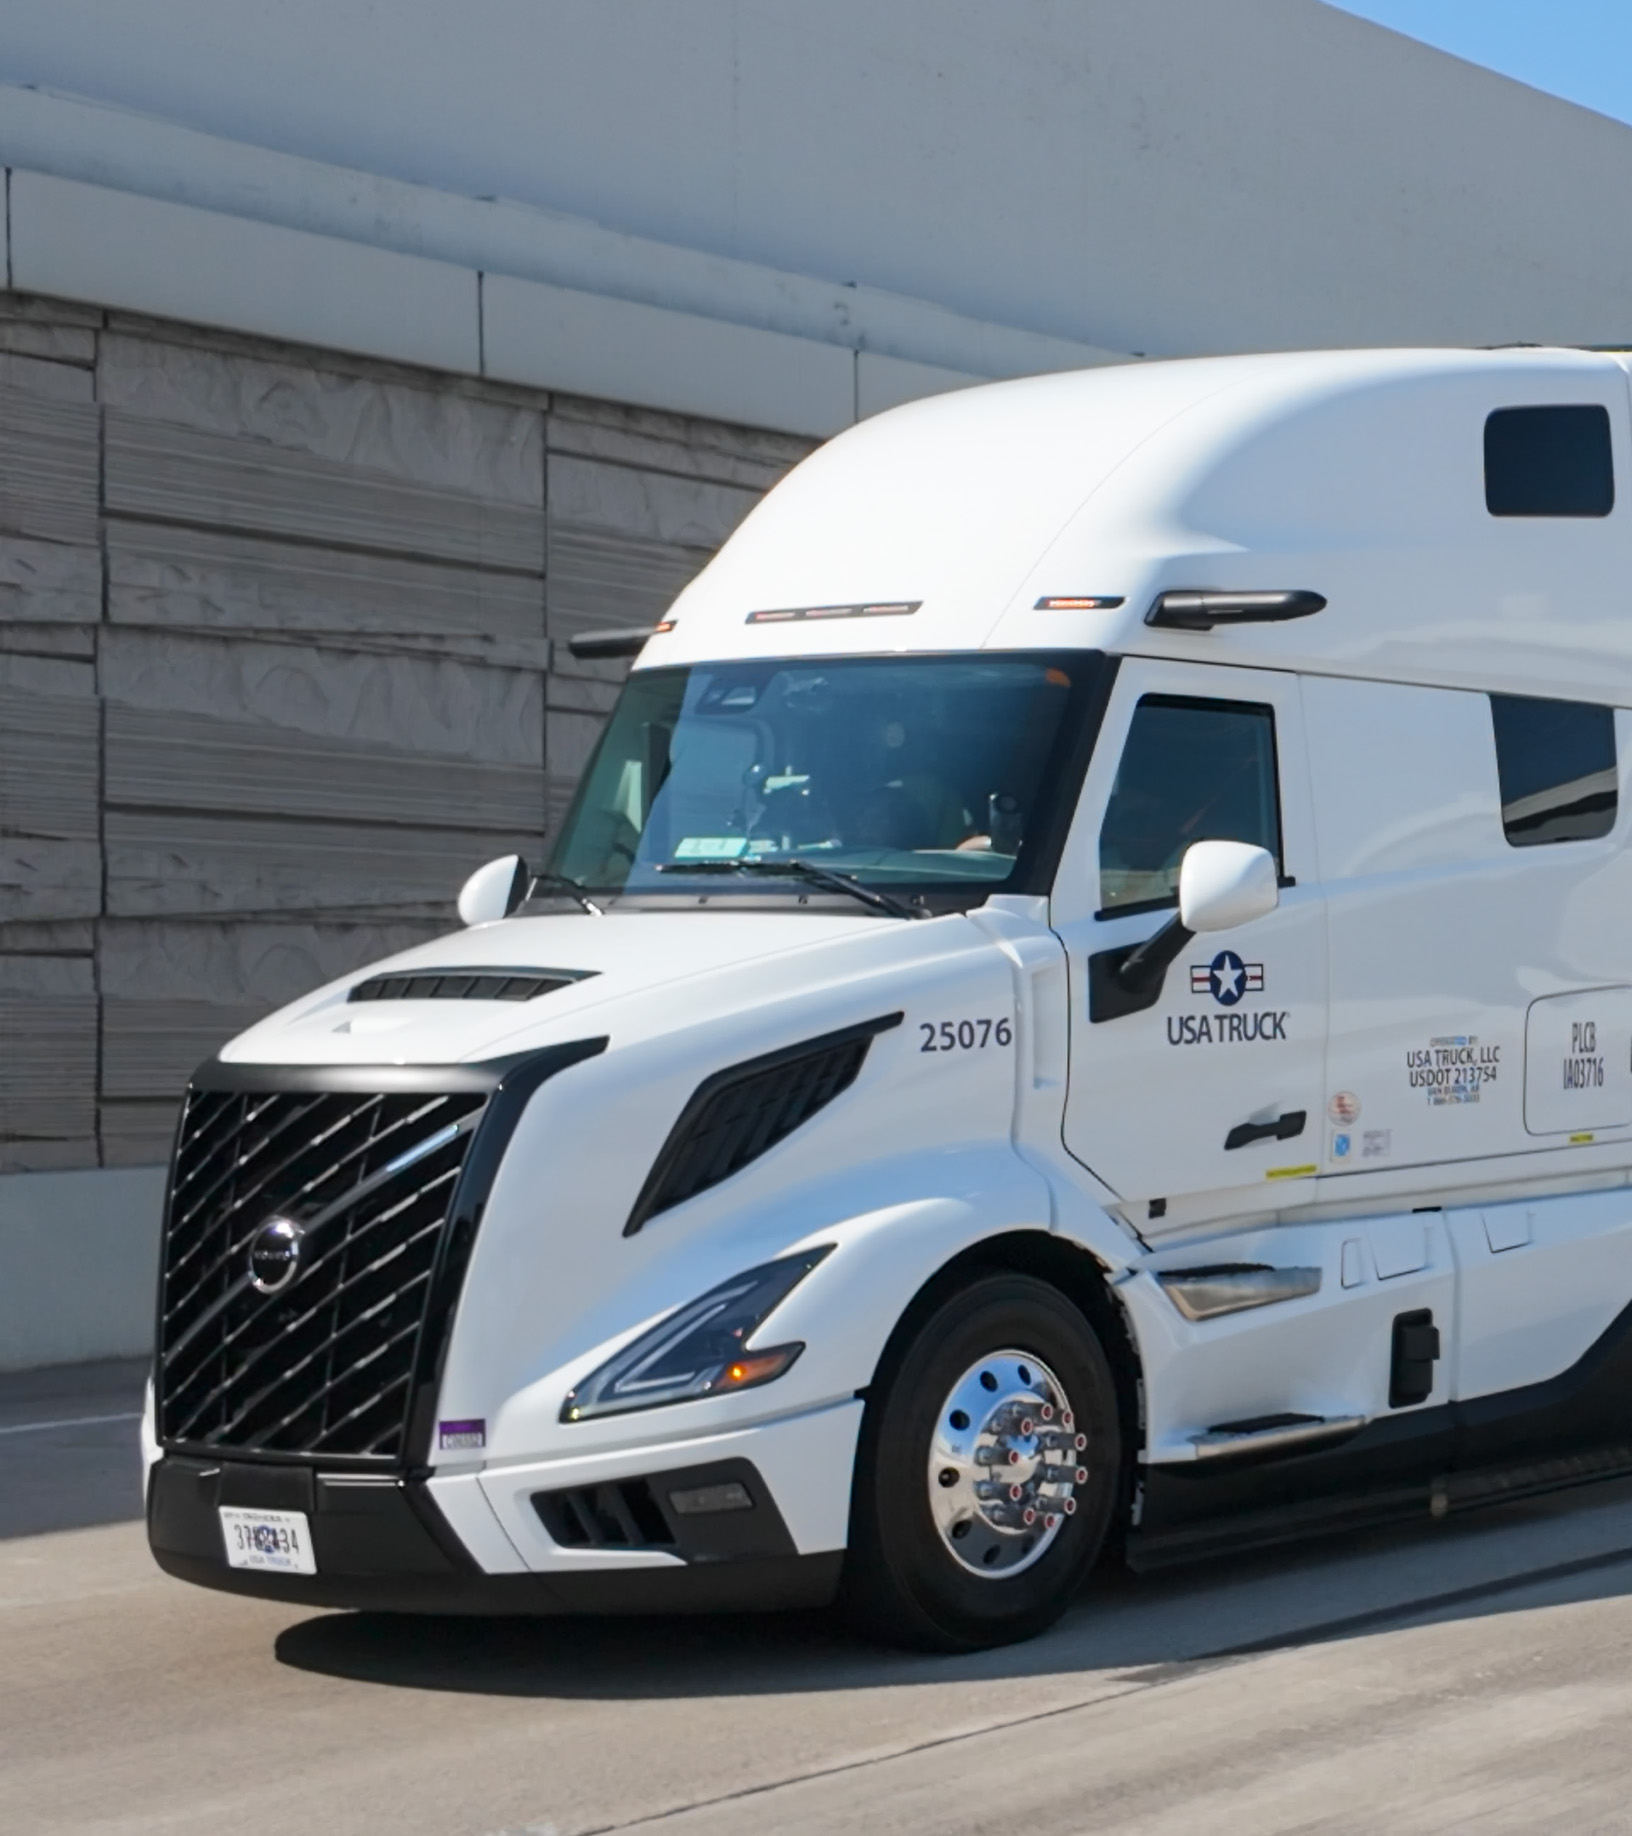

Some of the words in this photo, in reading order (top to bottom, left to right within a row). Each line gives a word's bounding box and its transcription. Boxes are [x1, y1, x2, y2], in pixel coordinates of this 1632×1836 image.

[919, 1017, 1012, 1052] 25076
[1572, 1021, 1596, 1053] PLCB
[1407, 1050, 1432, 1068] USA
[1480, 1045, 1500, 1063] LLC
[1409, 1068, 1451, 1088] USDOT
[1454, 1066, 1497, 1085] 213754
